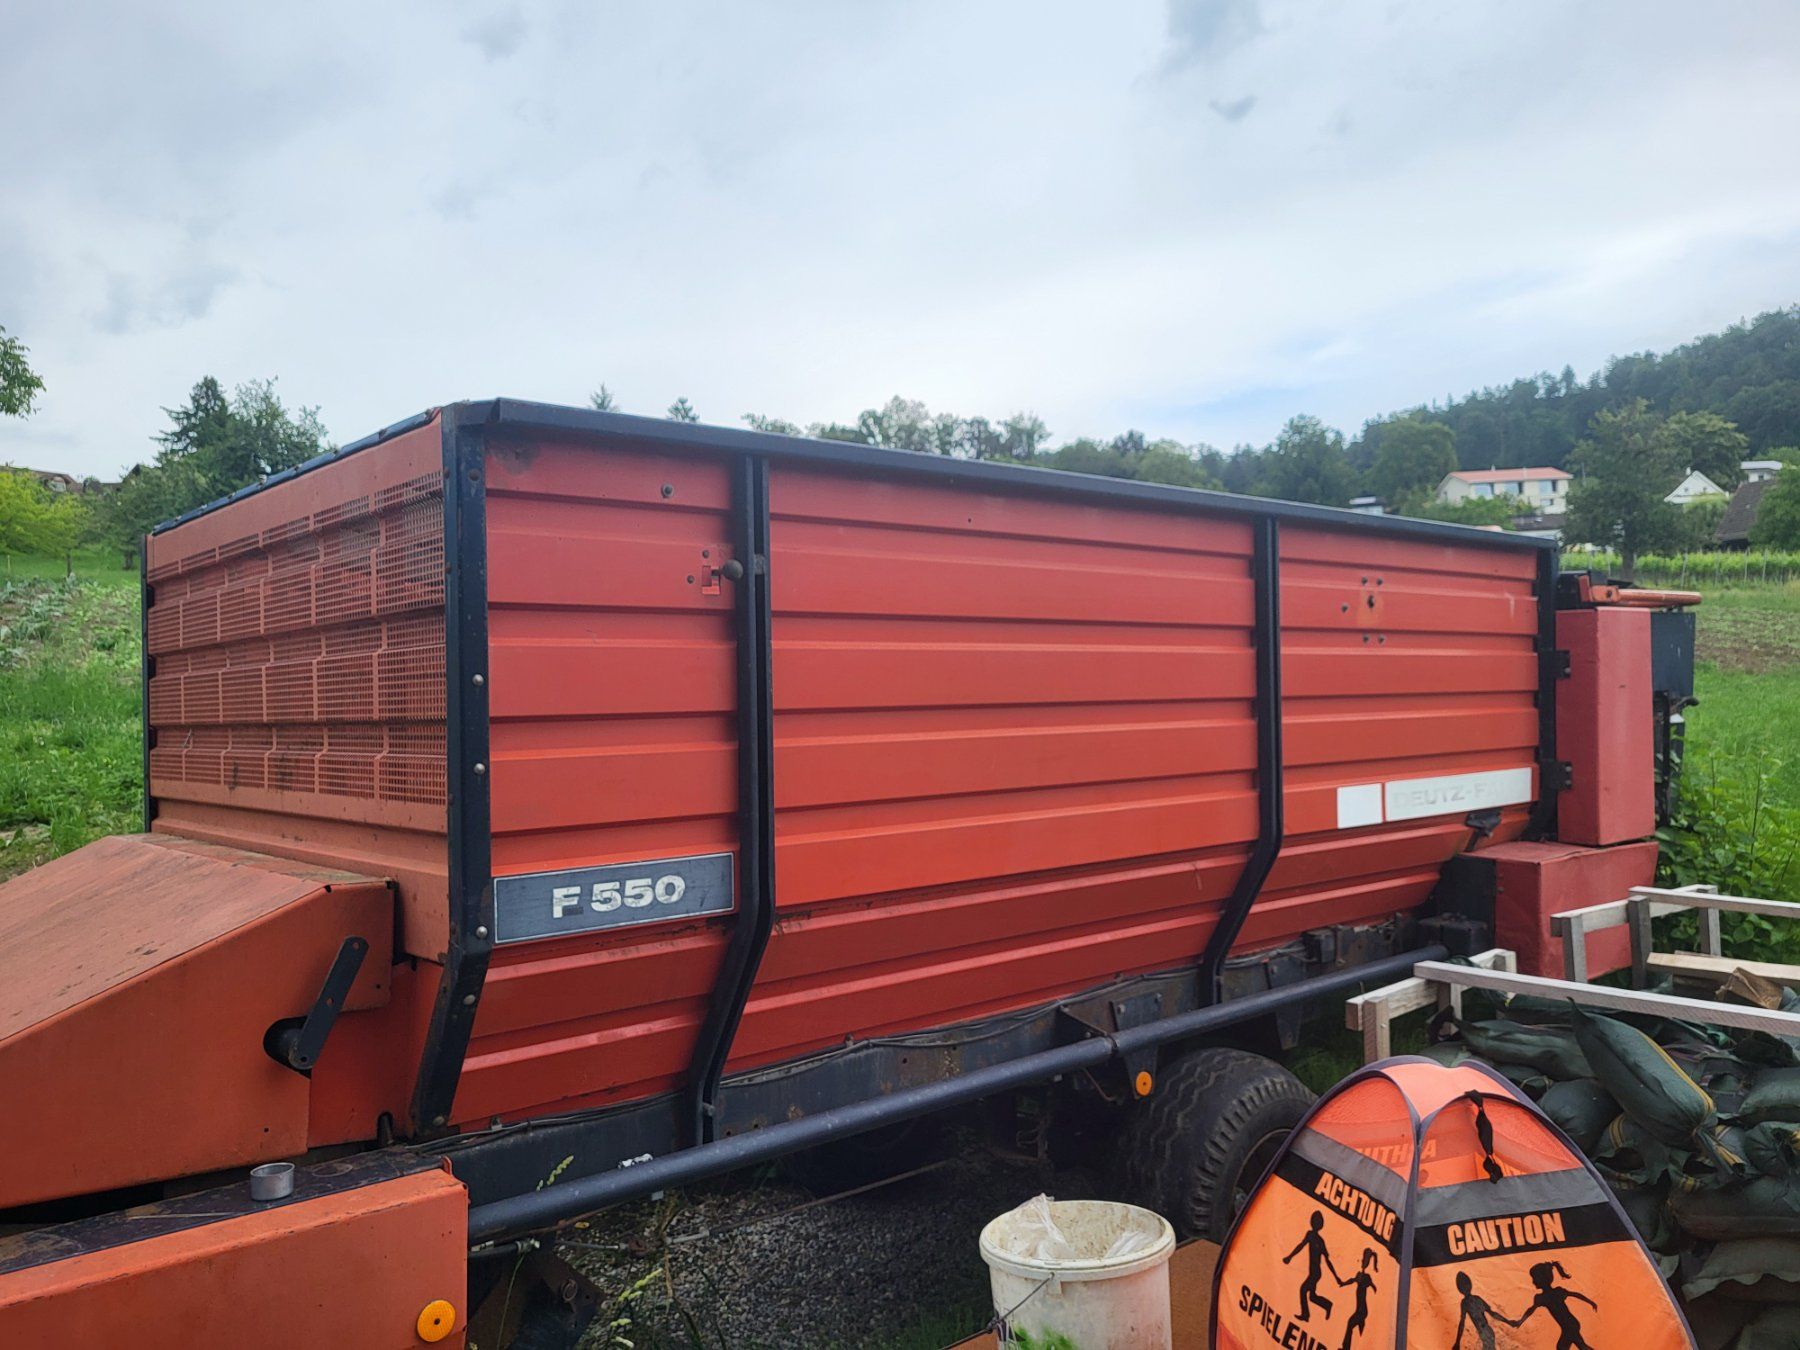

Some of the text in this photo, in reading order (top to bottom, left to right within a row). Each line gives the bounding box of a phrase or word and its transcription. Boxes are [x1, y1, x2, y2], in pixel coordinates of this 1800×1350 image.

[552, 874, 686, 918] F 550
[1314, 1171, 1396, 1242] ACHTUNG
[1447, 1212, 1566, 1256] CAUTION
